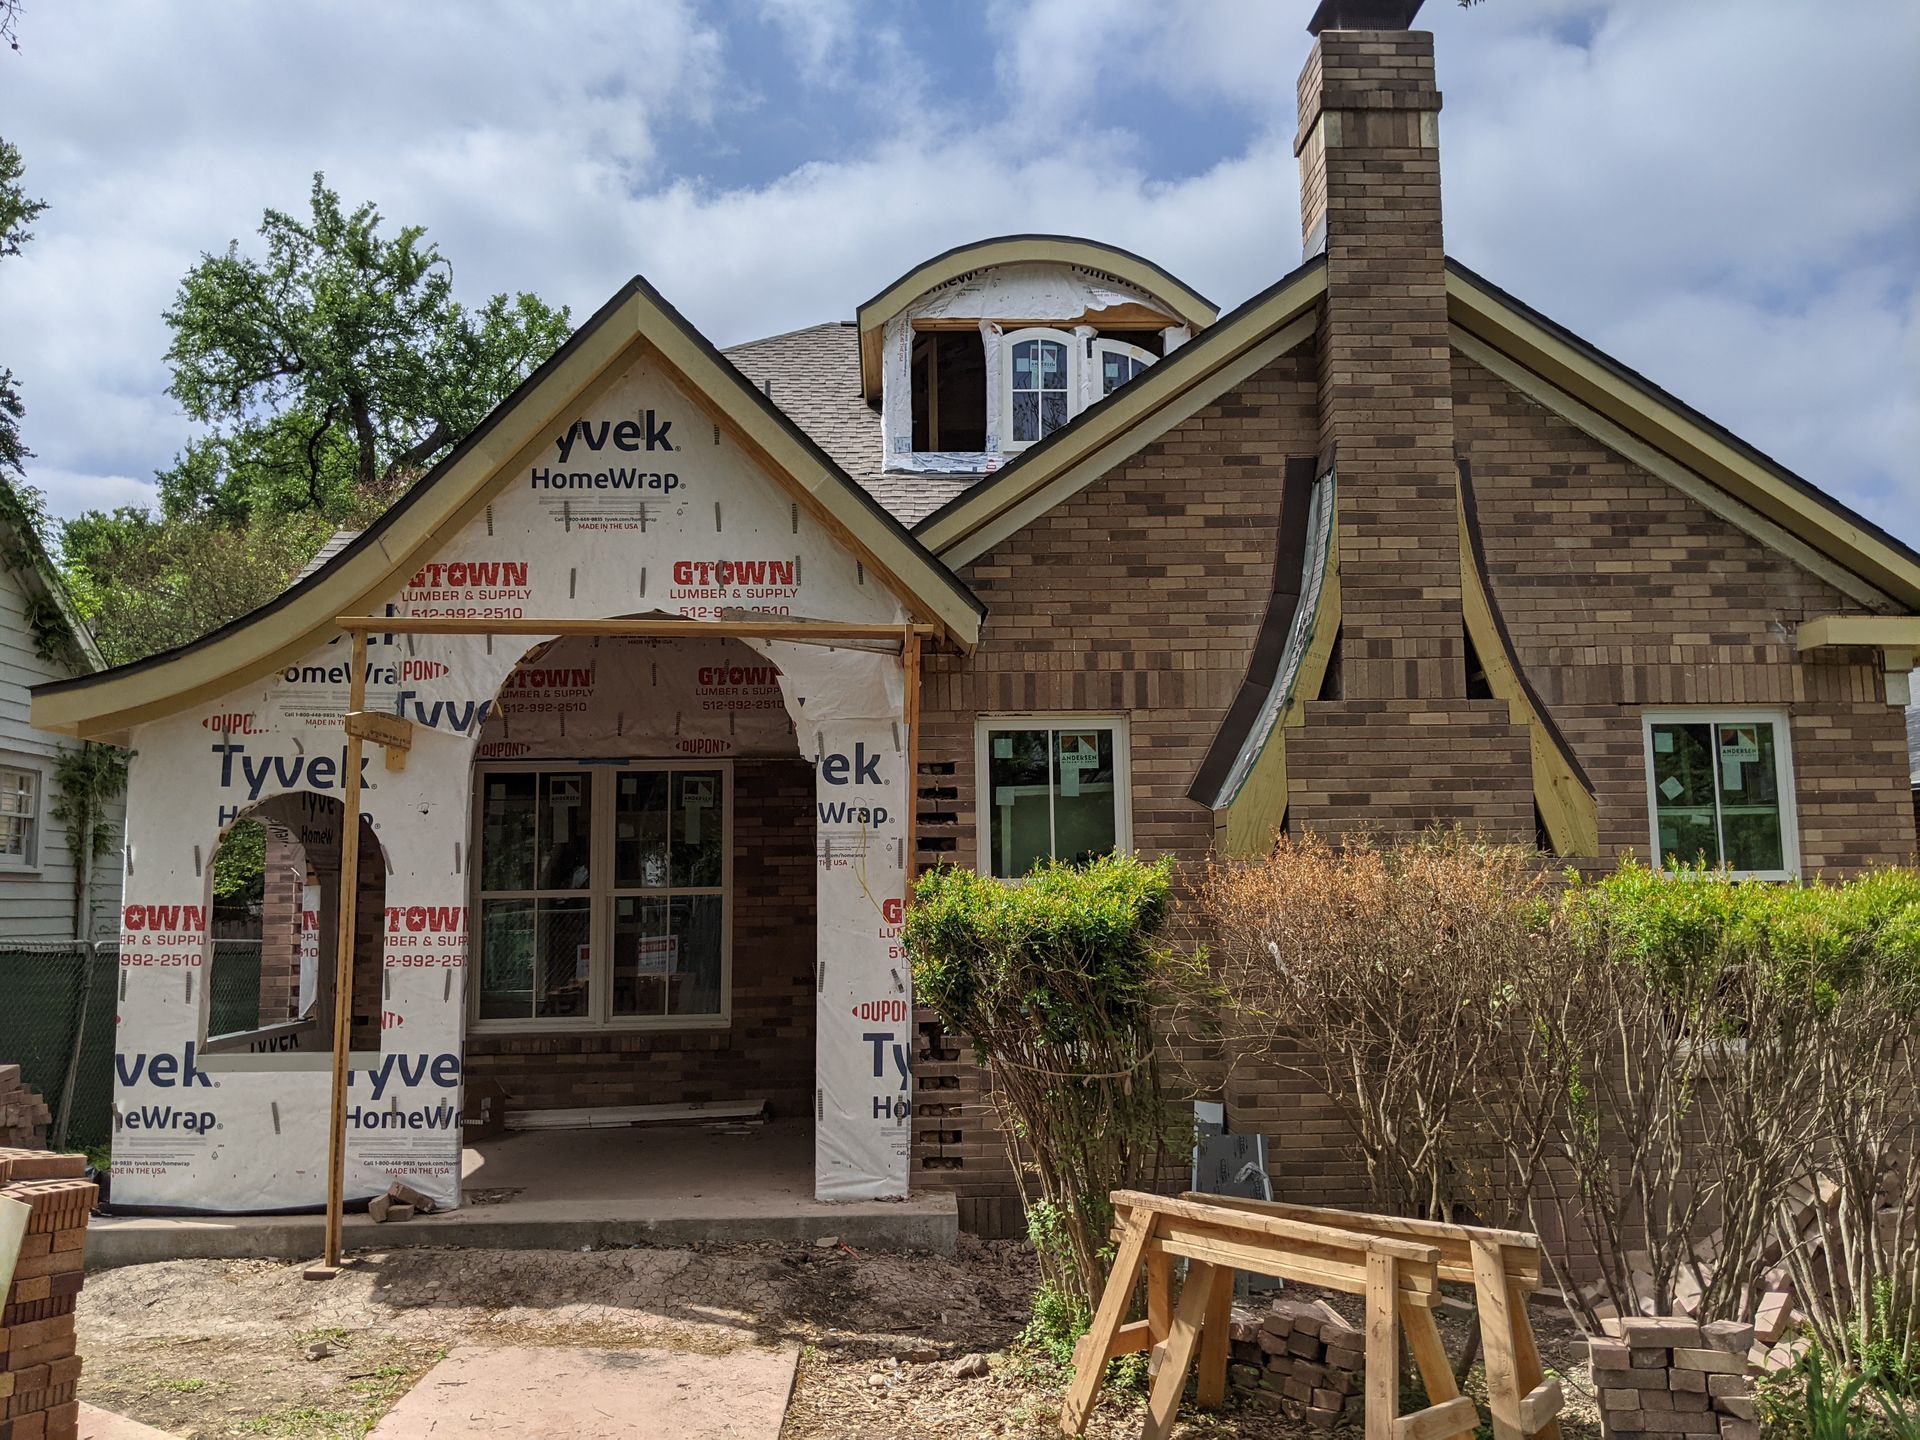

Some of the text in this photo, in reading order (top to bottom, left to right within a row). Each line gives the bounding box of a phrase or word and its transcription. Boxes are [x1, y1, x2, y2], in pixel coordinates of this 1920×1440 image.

[531, 468, 679, 494] HomeWrap
[673, 561, 794, 586] GTOWN
[402, 589, 533, 602] LUMBER & SUPPLY
[670, 588, 798, 599] LUMBER & SUPPLY
[411, 608, 522, 619] 512-992-2510
[504, 669, 591, 689] TOWN
[543, 689, 551, 698] &
[554, 689, 595, 698] SUPPLY
[695, 686, 782, 696] LUMBER & SUPP
[503, 702, 587, 713] 512-992-2510
[702, 700, 784, 710] 512-992-2510
[482, 742, 525, 757] DUPONT
[683, 739, 725, 754] DUPONT
[883, 898, 906, 924] G
[122, 904, 207, 932] OWN
[142, 934, 152, 946] &
[423, 935, 433, 947] &
[347, 1040, 465, 1101] yve
[126, 1167, 134, 1175] IN
[135, 1167, 150, 1175] THE
[151, 1167, 167, 1175] USA
[434, 1167, 450, 1175] USA
